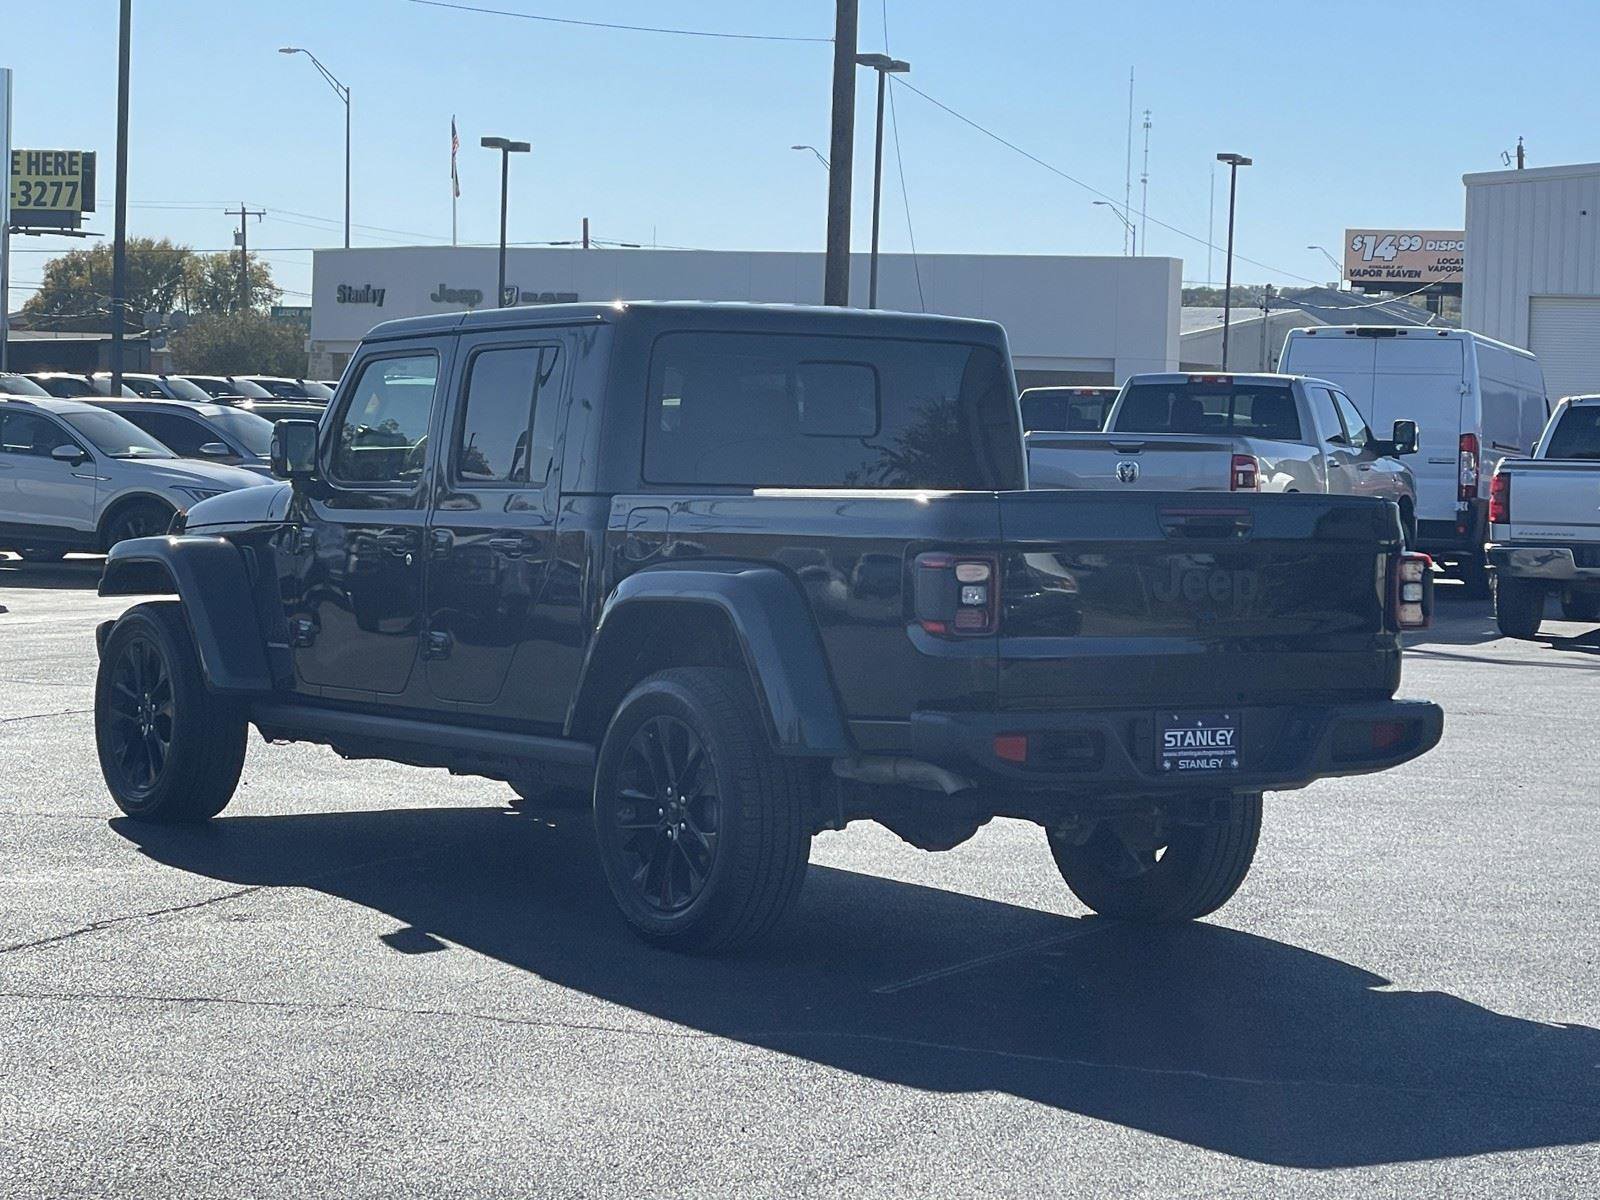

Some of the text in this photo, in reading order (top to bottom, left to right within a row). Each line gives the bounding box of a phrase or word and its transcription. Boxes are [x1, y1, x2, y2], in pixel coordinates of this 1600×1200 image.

[26, 151, 80, 176] HERE
[10, 181, 79, 208] -3277
[1349, 269, 1422, 278] VAPOR MAVEN
[430, 283, 484, 306] Jeep
[1152, 559, 1259, 612] Jeep
[1164, 730, 1234, 747] STANLEY
[1179, 759, 1223, 769] STANLEY
